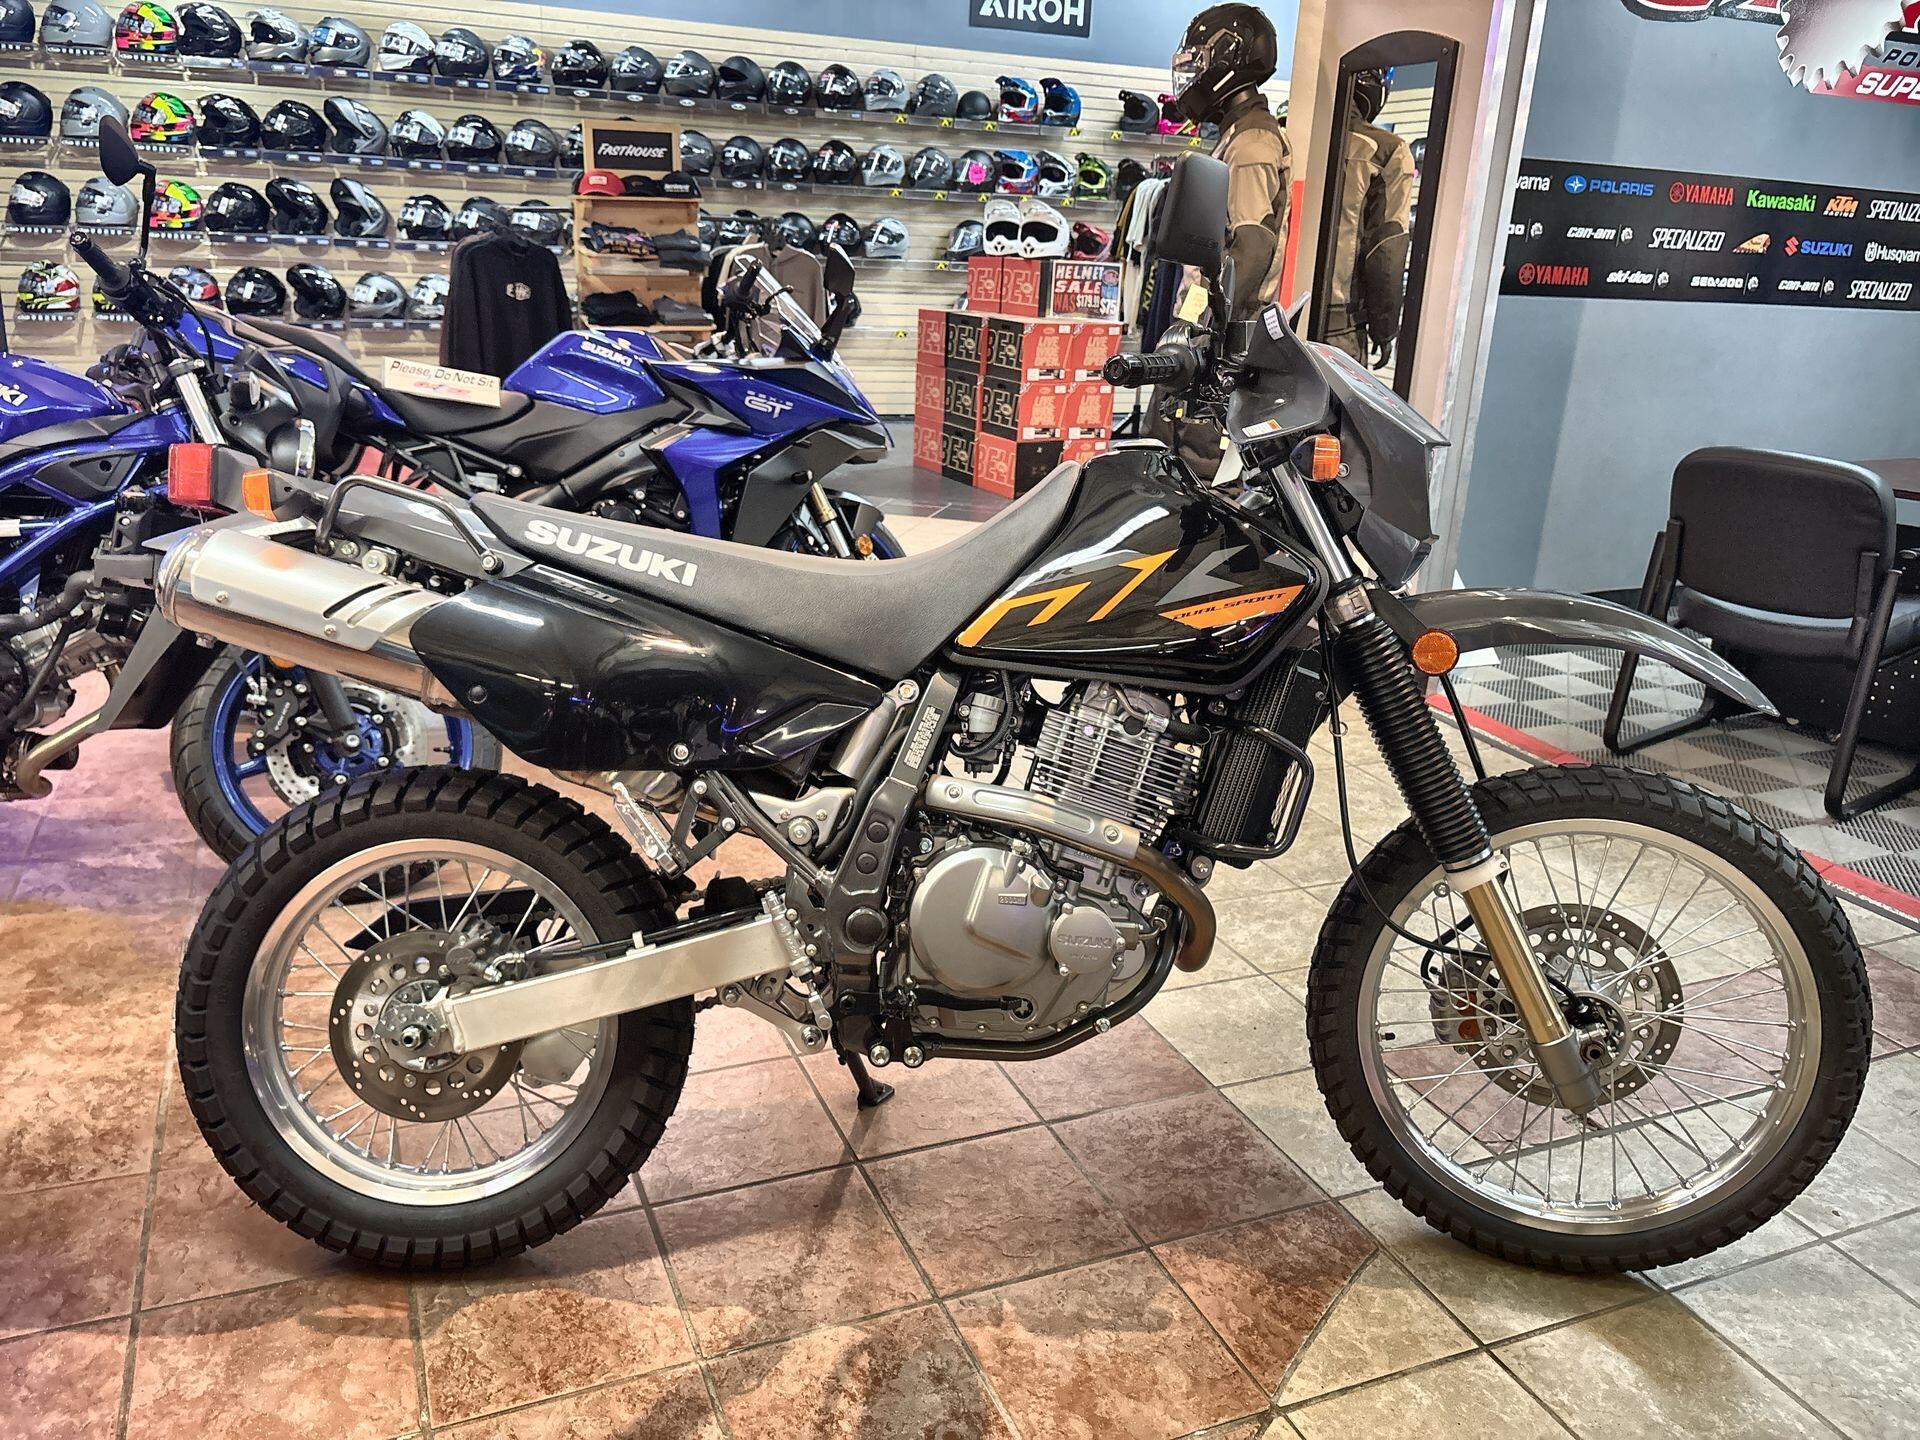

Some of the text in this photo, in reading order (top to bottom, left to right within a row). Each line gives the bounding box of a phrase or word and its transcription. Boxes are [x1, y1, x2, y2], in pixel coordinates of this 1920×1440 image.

[979, 0, 1085, 27] AIROH
[1882, 49, 1920, 68] PO
[597, 143, 668, 158] FASTHOUSE
[1589, 179, 1655, 197] POLARIS
[1685, 184, 1734, 207] YAMAHA
[1746, 189, 1817, 212] Kawasaki
[1826, 195, 1859, 213] KTM
[1648, 227, 1725, 252] SPECIALIZED
[1801, 240, 1853, 257] SUZUKI
[1056, 265, 1104, 280] HELMET
[1536, 264, 1590, 286] YAMAHA
[1054, 280, 1102, 294] SALE
[1846, 280, 1912, 301] SPECIALIZED
[1054, 293, 1076, 312] WAS
[580, 340, 633, 367] SUZUKI
[435, 369, 452, 380] Do
[454, 372, 475, 385] Not
[478, 376, 494, 388] Sit
[524, 519, 698, 587] SUZUKI
[1172, 592, 1287, 621] DUAL SPORT
[1057, 934, 1112, 949] SUZUKI
